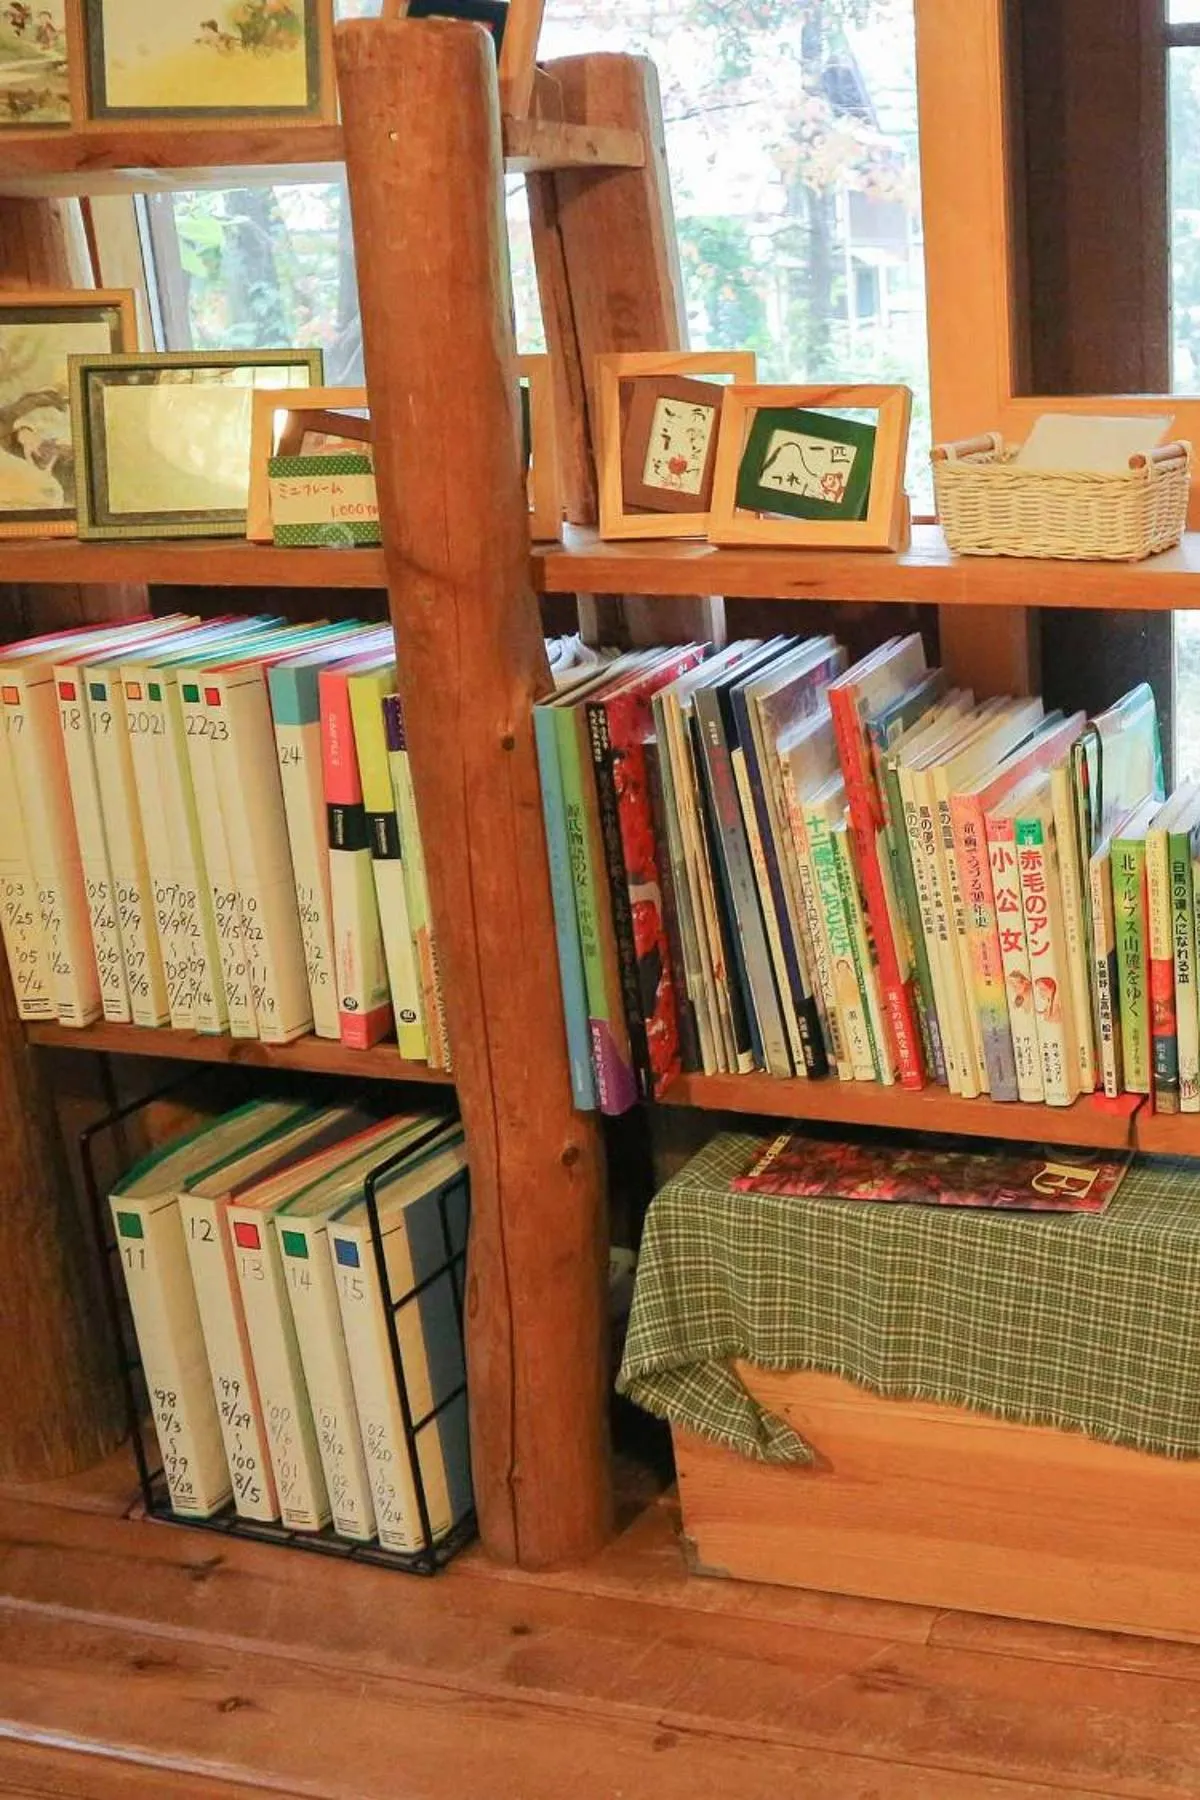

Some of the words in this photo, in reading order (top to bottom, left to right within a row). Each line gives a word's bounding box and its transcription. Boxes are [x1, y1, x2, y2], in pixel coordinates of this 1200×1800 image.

[61, 708, 81, 731] 18
[92, 711, 112, 734] 19
[186, 715, 208, 736] 22
[207, 720, 230, 740] 23
[281, 746, 303, 765] 24
[992, 847, 1023, 953] 小公女
[1020, 850, 1050, 957] 赤毛のアン
[189, 1216, 215, 1242] 12
[124, 1246, 145, 1271] 11
[242, 1257, 266, 1281] 13
[290, 1266, 313, 1290] 14
[342, 1274, 365, 1301] 15
[154, 1387, 177, 1409] '98
[217, 1376, 241, 1399] '99
[220, 1401, 251, 1430] 8/29
[231, 1452, 256, 1471] '00
[233, 1471, 262, 1504] 8/5
